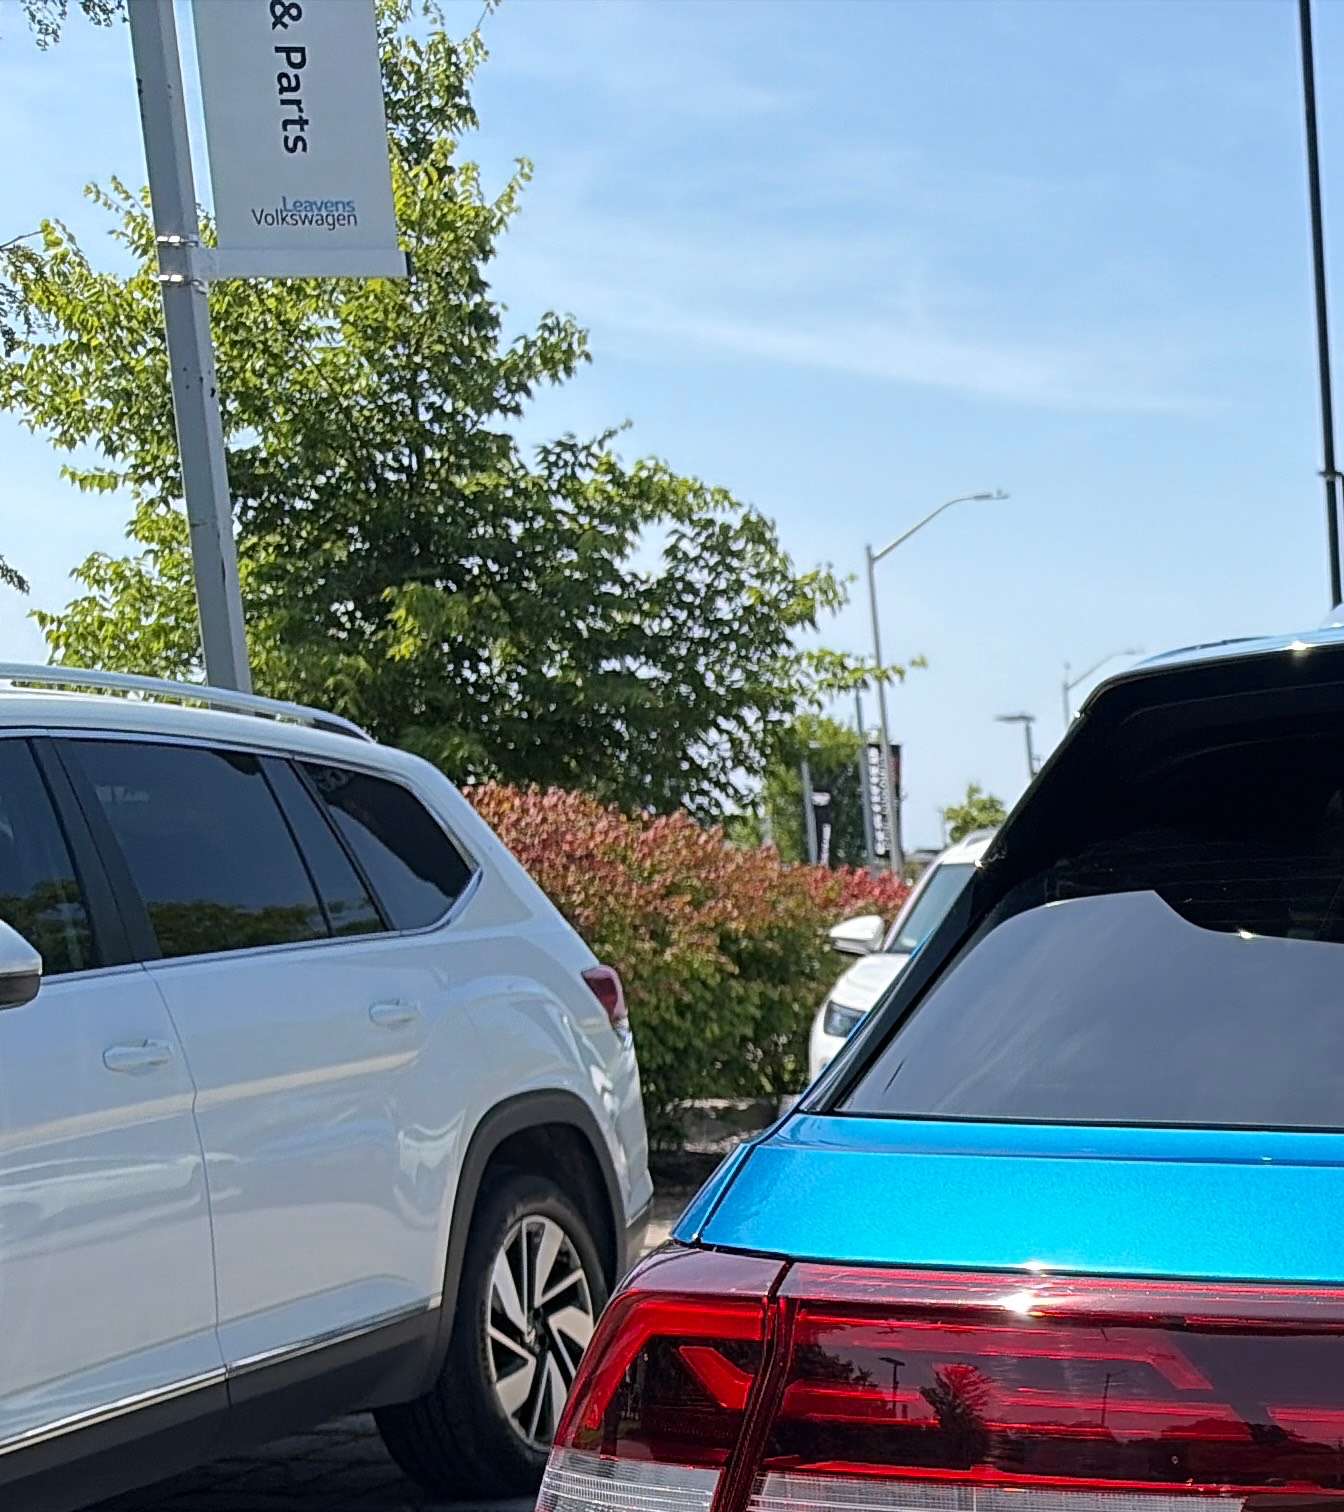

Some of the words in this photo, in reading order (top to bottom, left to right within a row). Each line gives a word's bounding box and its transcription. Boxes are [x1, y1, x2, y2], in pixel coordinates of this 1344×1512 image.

[270, 0, 303, 30] &
[274, 46, 310, 154] Parts
[282, 196, 356, 213] Leavens
[251, 208, 358, 231] Volkswagen
